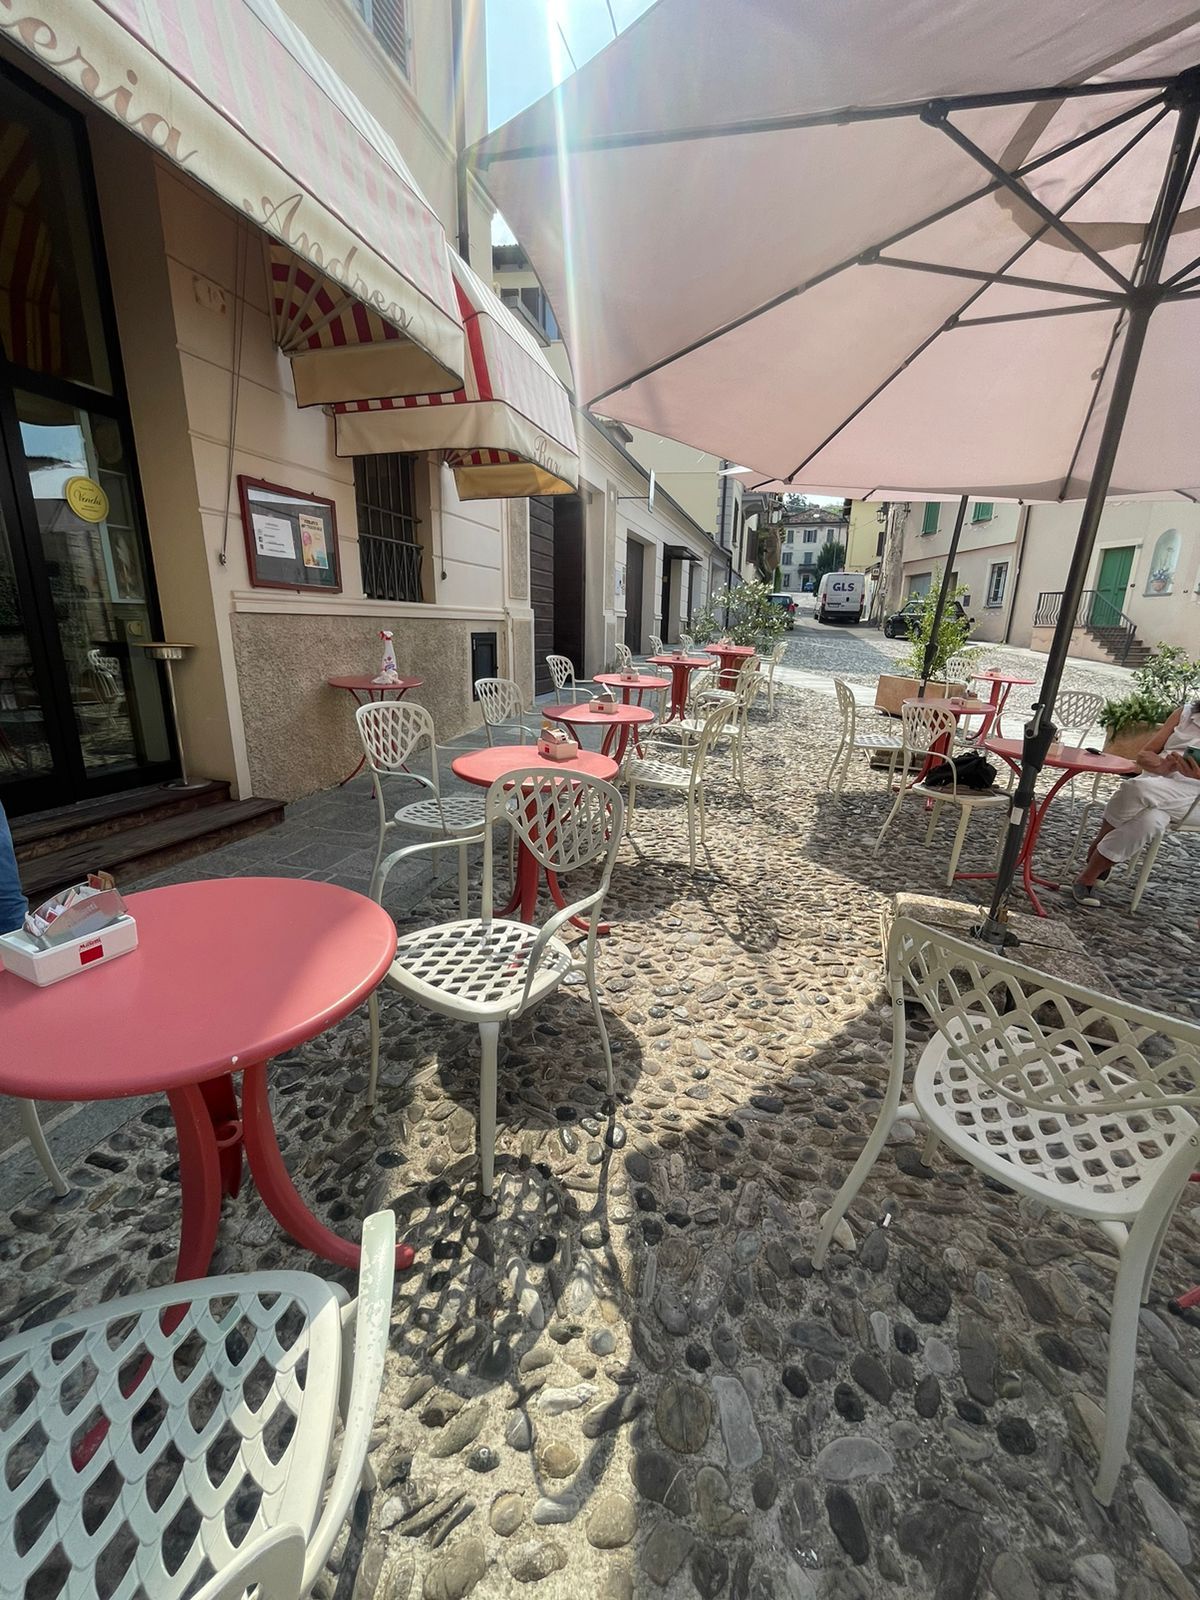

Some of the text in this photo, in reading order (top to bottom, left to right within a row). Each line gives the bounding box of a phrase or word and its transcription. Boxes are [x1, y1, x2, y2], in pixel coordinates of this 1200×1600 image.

[0, 0, 413, 330] eria Andrea
[832, 582, 855, 591] GLS
